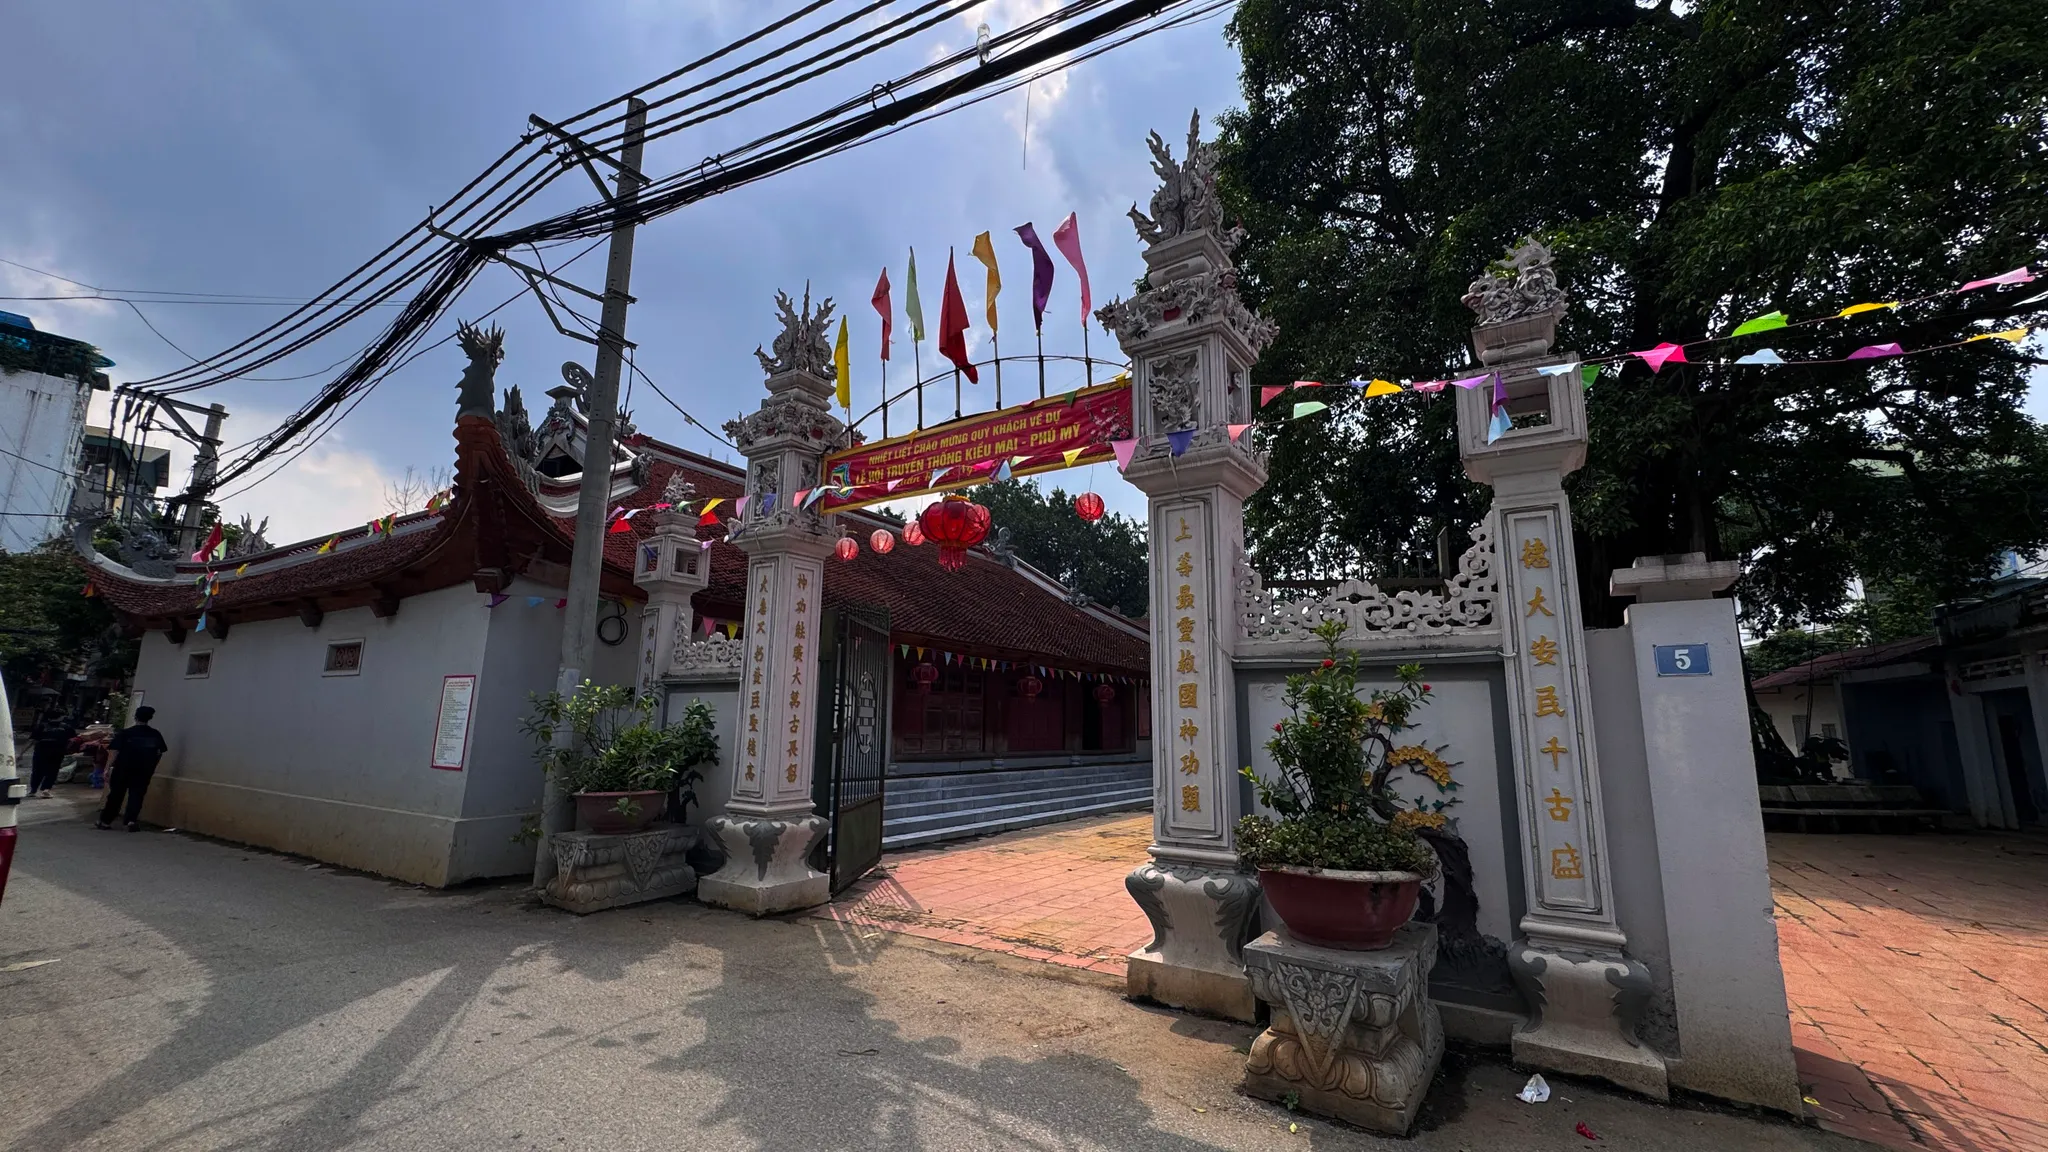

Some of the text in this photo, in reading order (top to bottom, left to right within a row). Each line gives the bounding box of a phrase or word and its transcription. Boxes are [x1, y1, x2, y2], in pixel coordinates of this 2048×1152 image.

[855, 467, 866, 484] LỄ
[868, 469, 884, 484] HỘI
[886, 457, 924, 477] TRUYỀN
[927, 449, 962, 469] THỐNG
[965, 440, 991, 461] KIỀU
[994, 437, 1018, 454] MAI
[1029, 427, 1056, 447] PHÚ
[1060, 421, 1081, 441] MỸ
[868, 451, 892, 465] NHIỆT
[894, 446, 912, 461] LIỆT
[914, 439, 938, 454] CHÀO
[940, 433, 968, 449] MỪNG
[992, 418, 1027, 436] KHÁCH
[1029, 413, 1042, 427] VỀ
[1045, 409, 1062, 425] DỰ
[1674, 648, 1691, 670] 5
